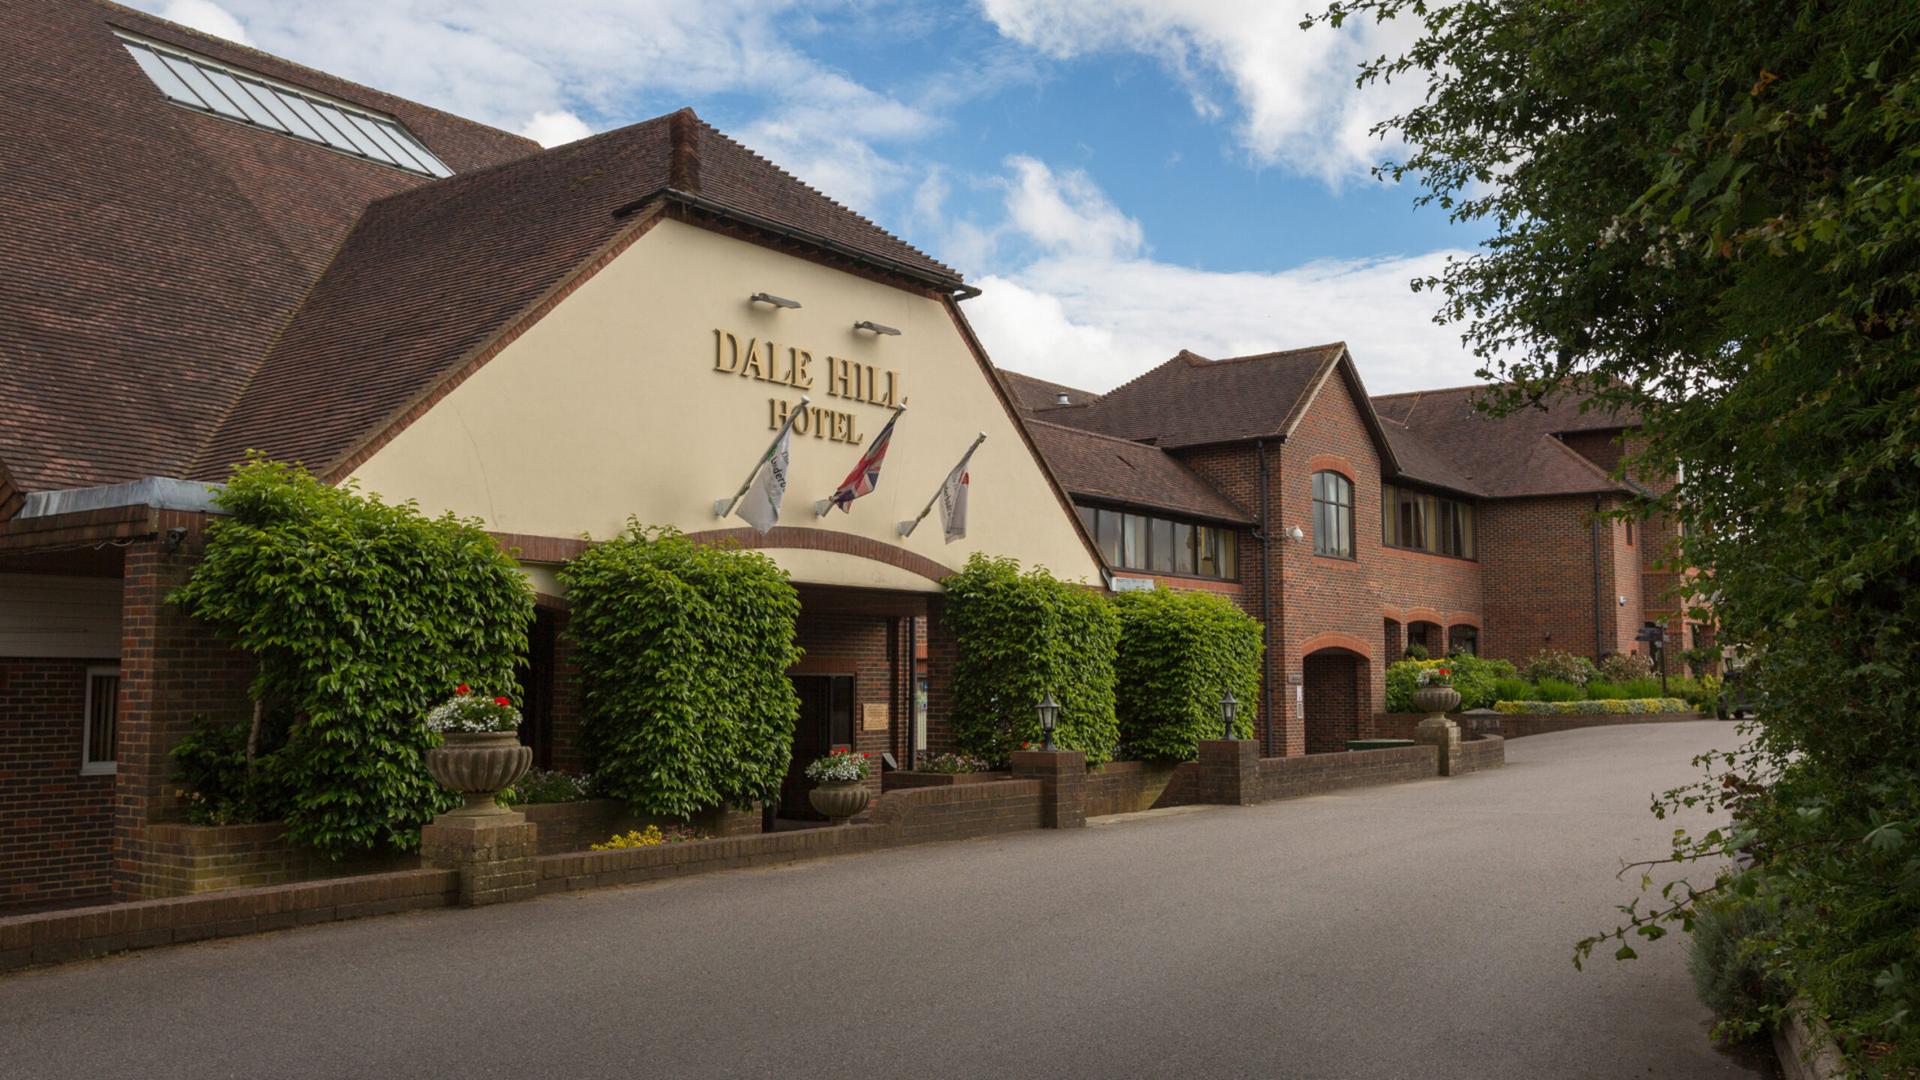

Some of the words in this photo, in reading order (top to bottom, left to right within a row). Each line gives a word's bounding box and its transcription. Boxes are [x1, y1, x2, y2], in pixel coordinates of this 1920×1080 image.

[713, 328, 813, 390] DALE
[826, 356, 908, 410] HILL
[768, 398, 863, 445] HOTEL
